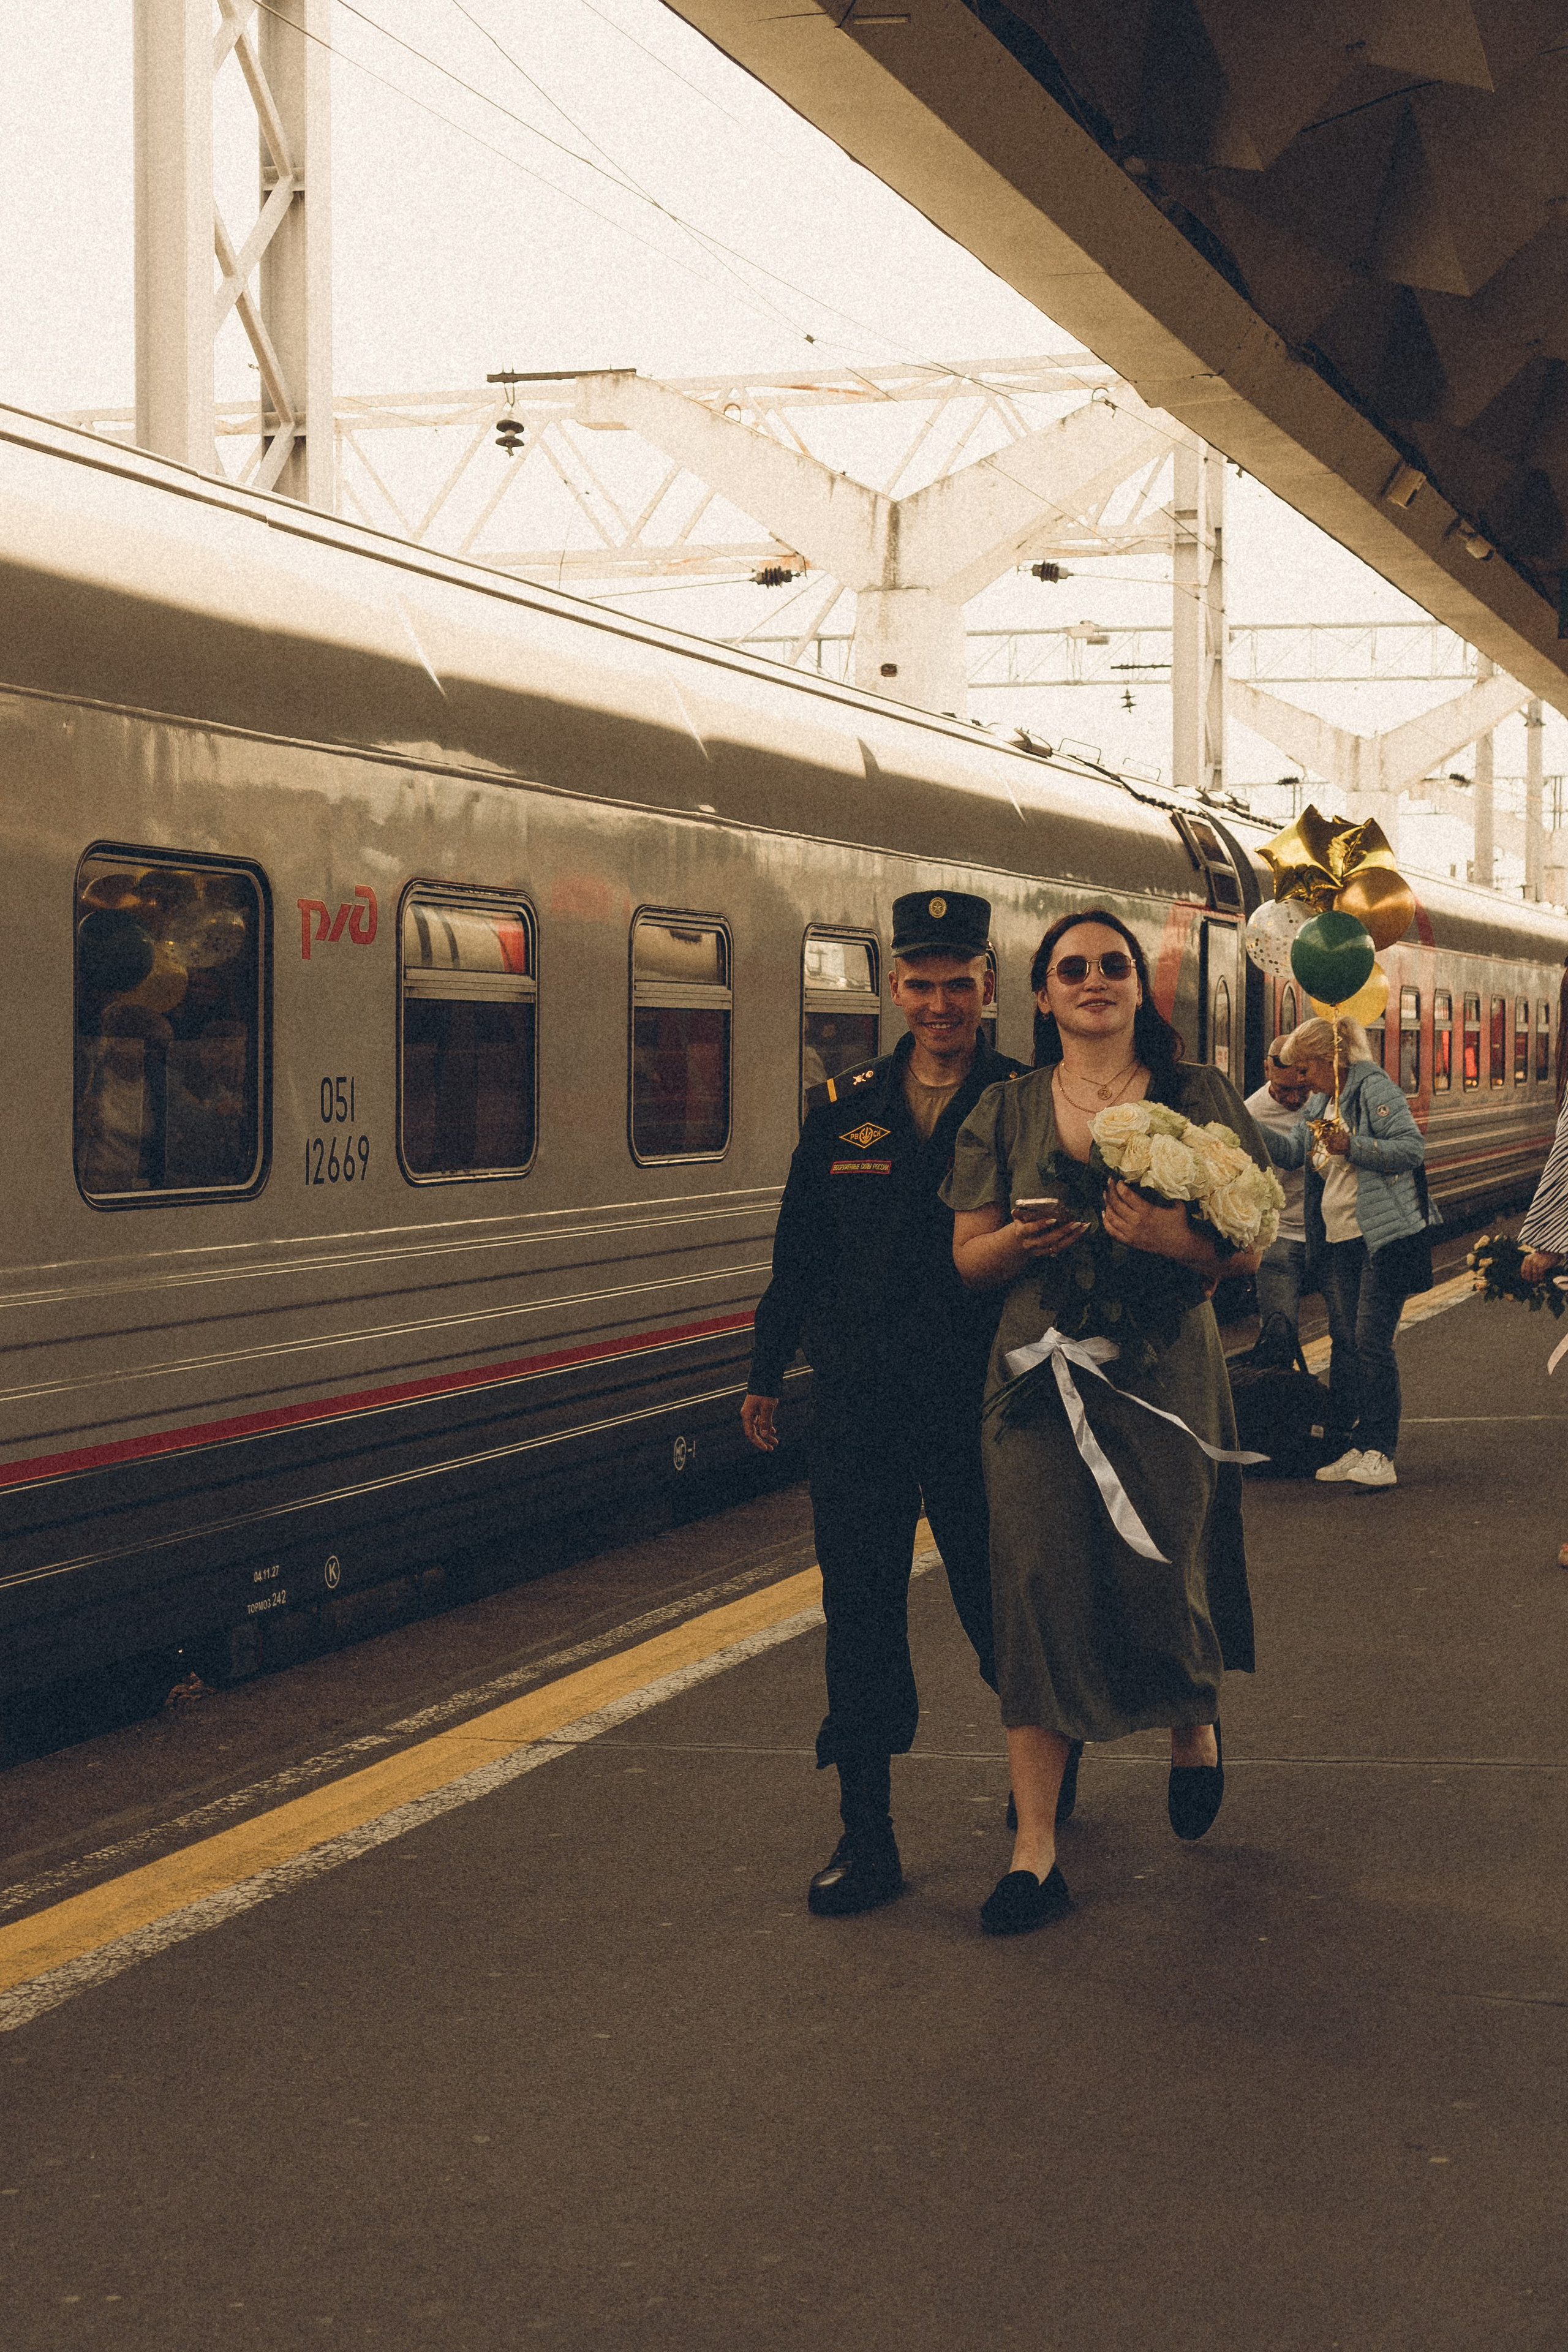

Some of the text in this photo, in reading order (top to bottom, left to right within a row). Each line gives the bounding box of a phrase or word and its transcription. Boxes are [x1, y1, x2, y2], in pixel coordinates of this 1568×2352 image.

[320, 1076, 355, 1123] 051
[305, 1134, 371, 1186] 12669
[247, 1589, 287, 1615] ТОРМОЗ 242
